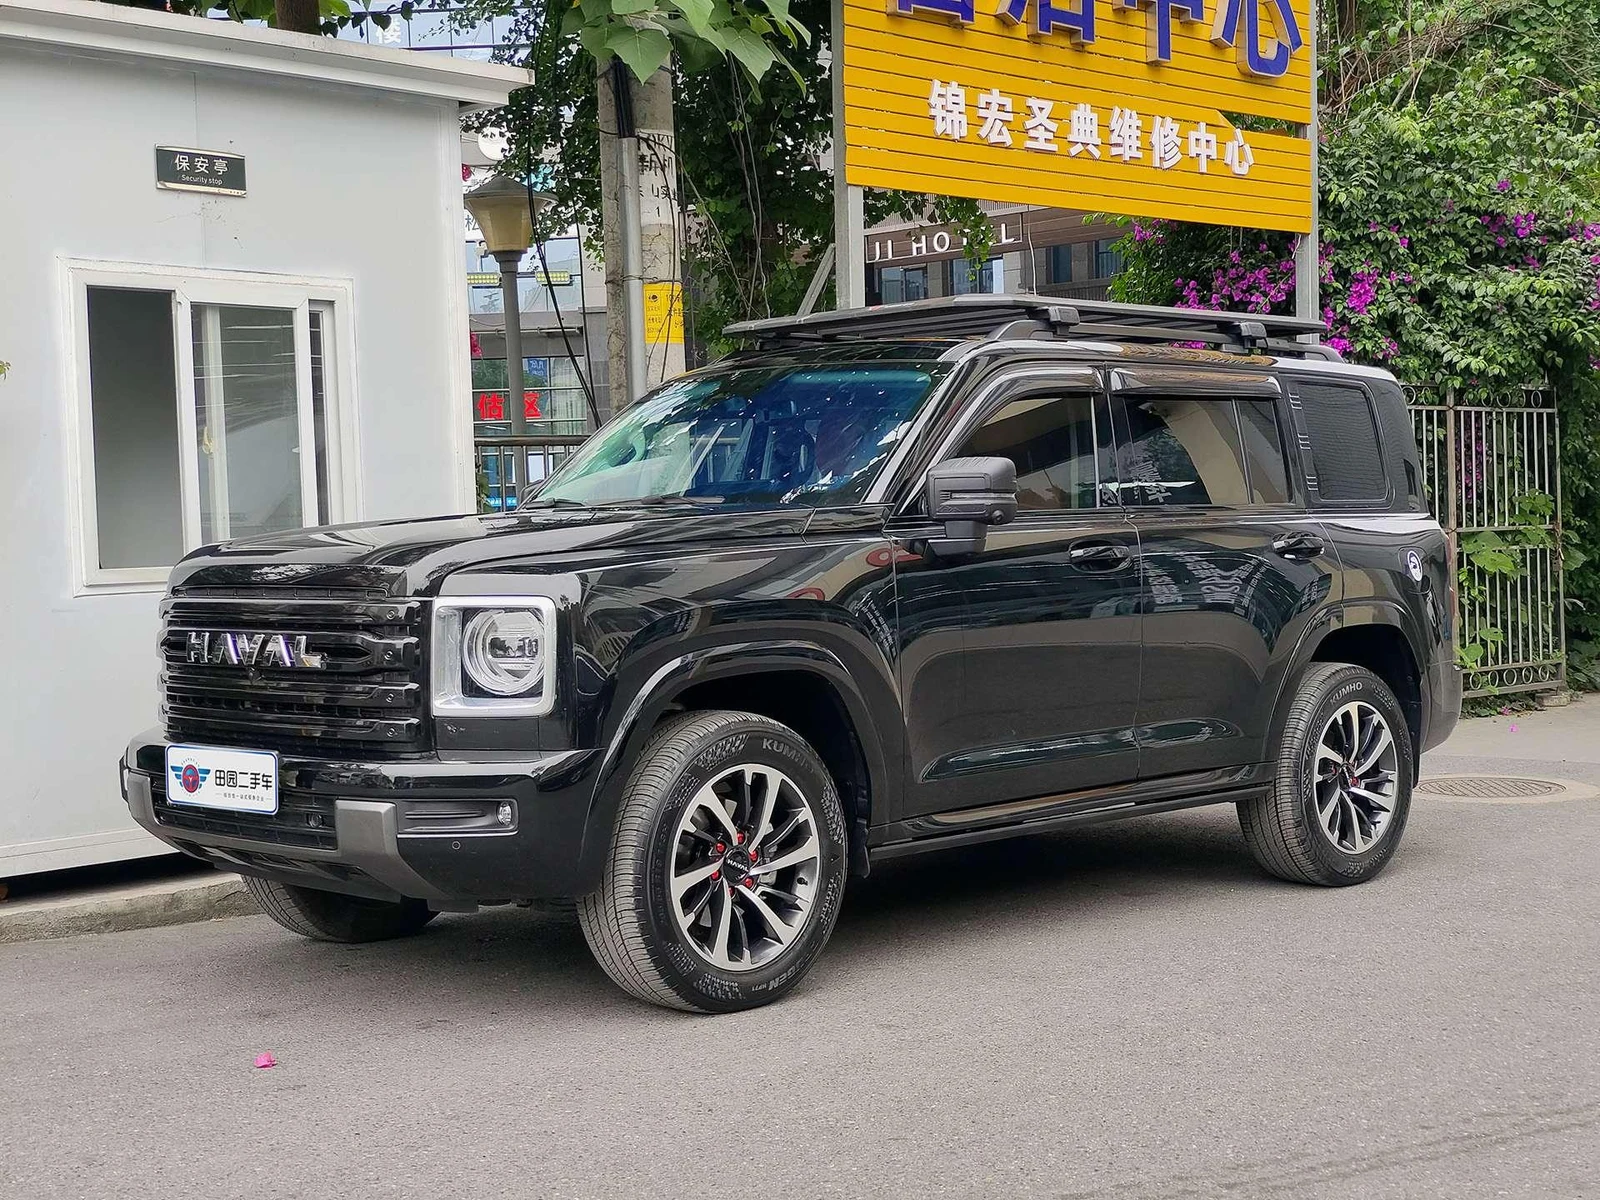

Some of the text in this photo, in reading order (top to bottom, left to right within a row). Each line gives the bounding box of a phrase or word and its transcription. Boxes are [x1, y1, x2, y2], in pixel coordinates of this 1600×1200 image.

[887, 0, 1304, 79] 中心
[928, 79, 1256, 177] 锦宏圣典维修中心
[174, 153, 229, 175] 保安亭
[181, 174, 223, 186] Security stop
[874, 222, 1015, 262] JI HOL
[186, 631, 327, 668] HAVAL
[1329, 680, 1364, 706] KUMHO
[214, 768, 273, 791] 田园二手车
[727, 858, 750, 873] HAVAL
